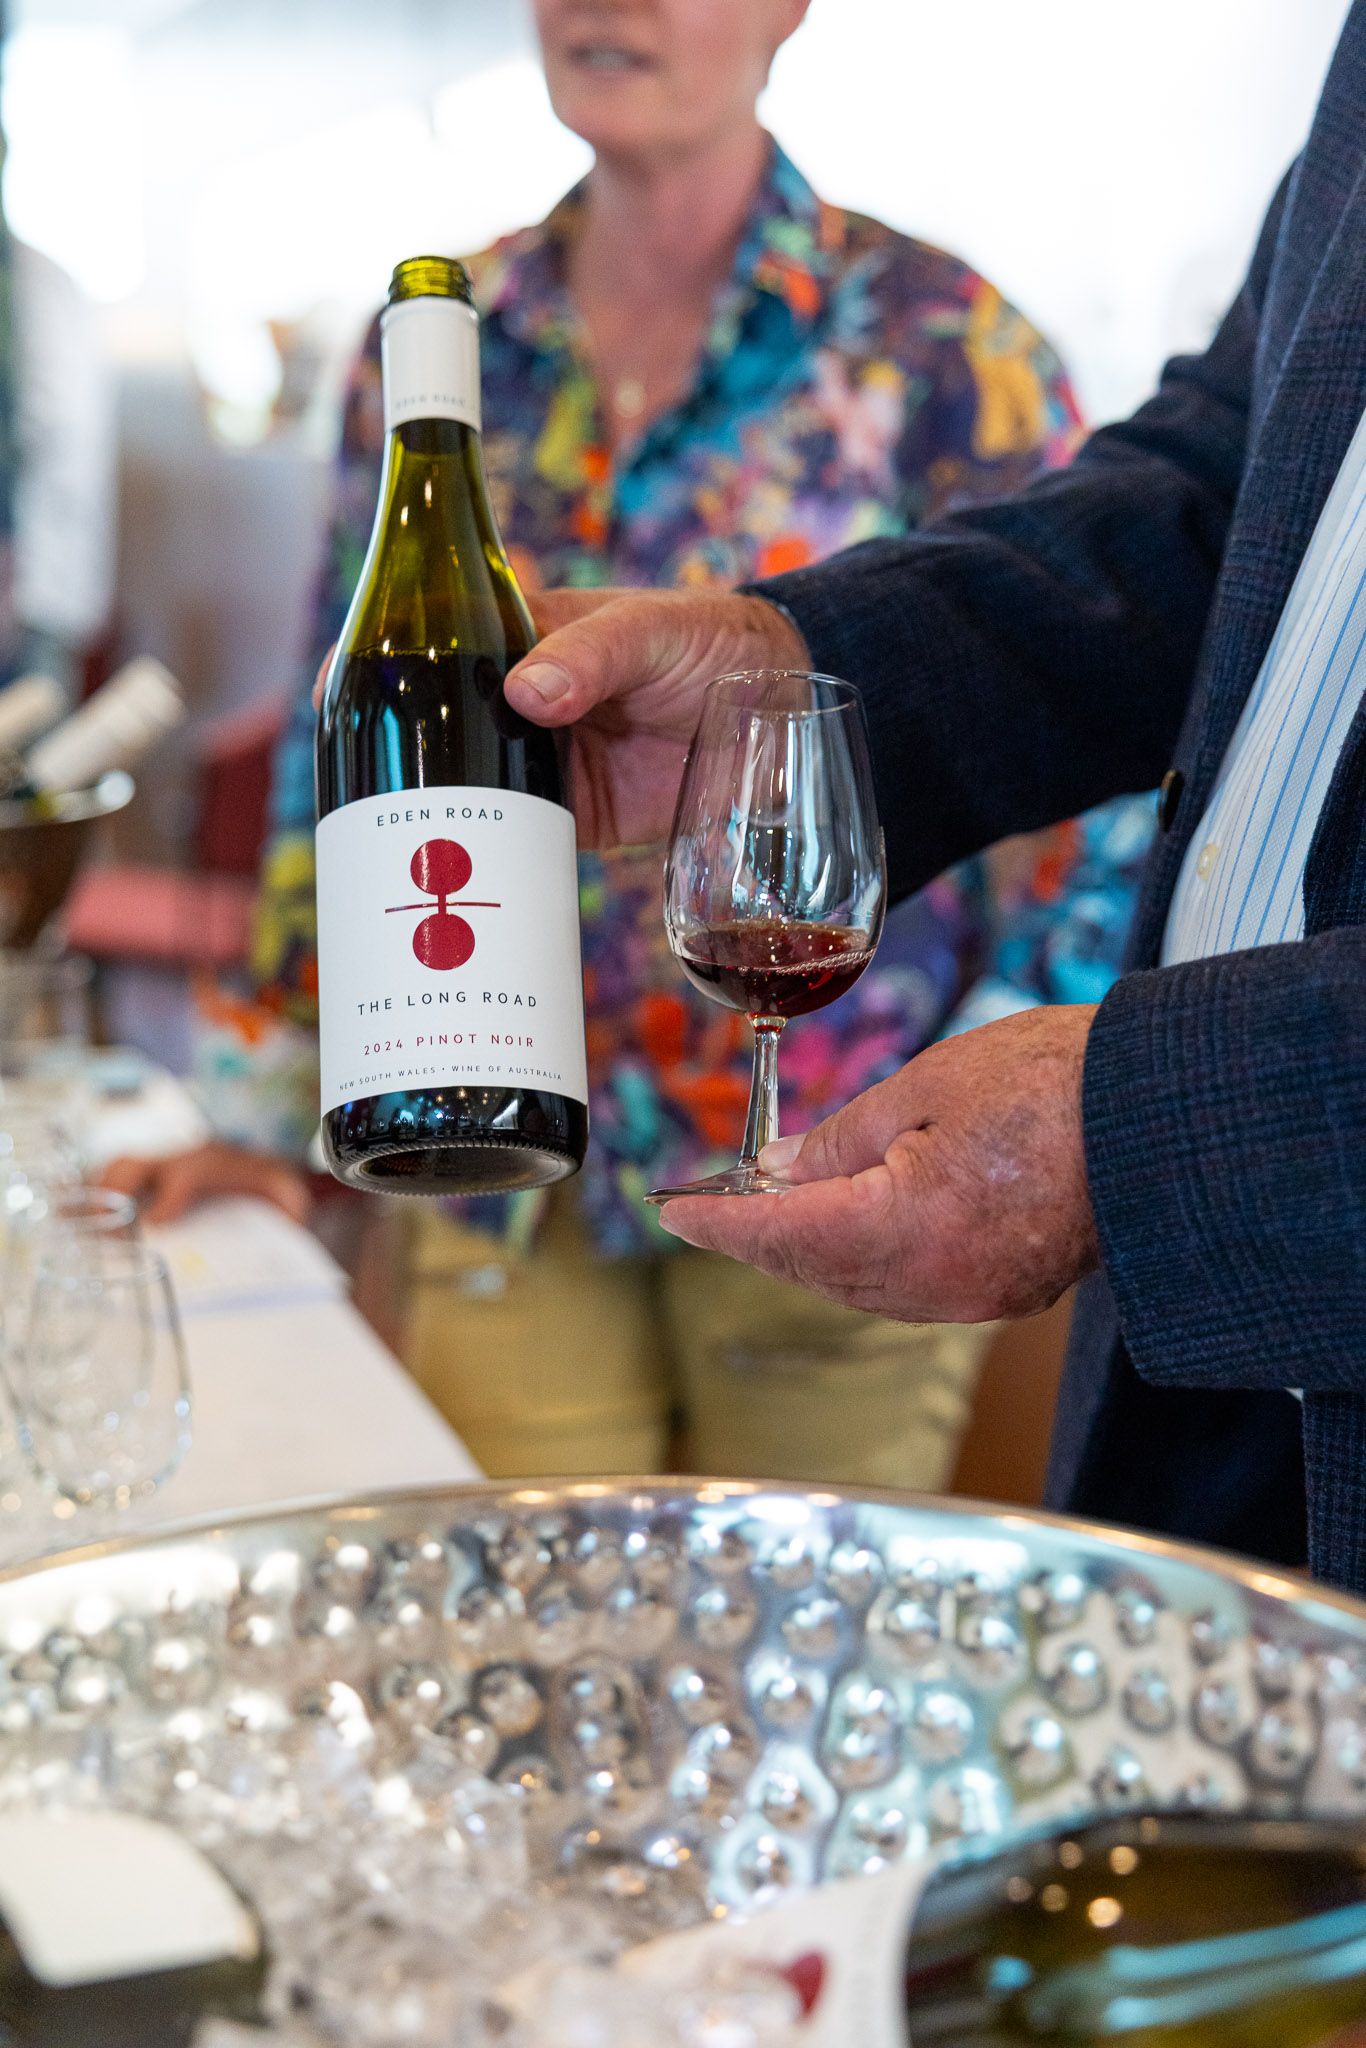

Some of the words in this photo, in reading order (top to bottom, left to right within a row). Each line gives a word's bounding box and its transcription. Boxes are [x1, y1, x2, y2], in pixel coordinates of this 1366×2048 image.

[377, 808, 430, 827] EDEN
[446, 807, 503, 821] ROAD
[357, 997, 393, 1016] THE
[407, 991, 467, 1007] LONG
[482, 991, 537, 1007] ROAD
[363, 1038, 404, 1056] 2024
[416, 1033, 477, 1047] PINOT
[491, 1033, 534, 1048] NOIR
[339, 1080, 355, 1091] NEW
[359, 1072, 391, 1085] SOUTH
[398, 1066, 436, 1077] WALES
[451, 1065, 481, 1073] WINE
[488, 1065, 501, 1073] OF
[508, 1066, 562, 1081] AUSTRALIA
